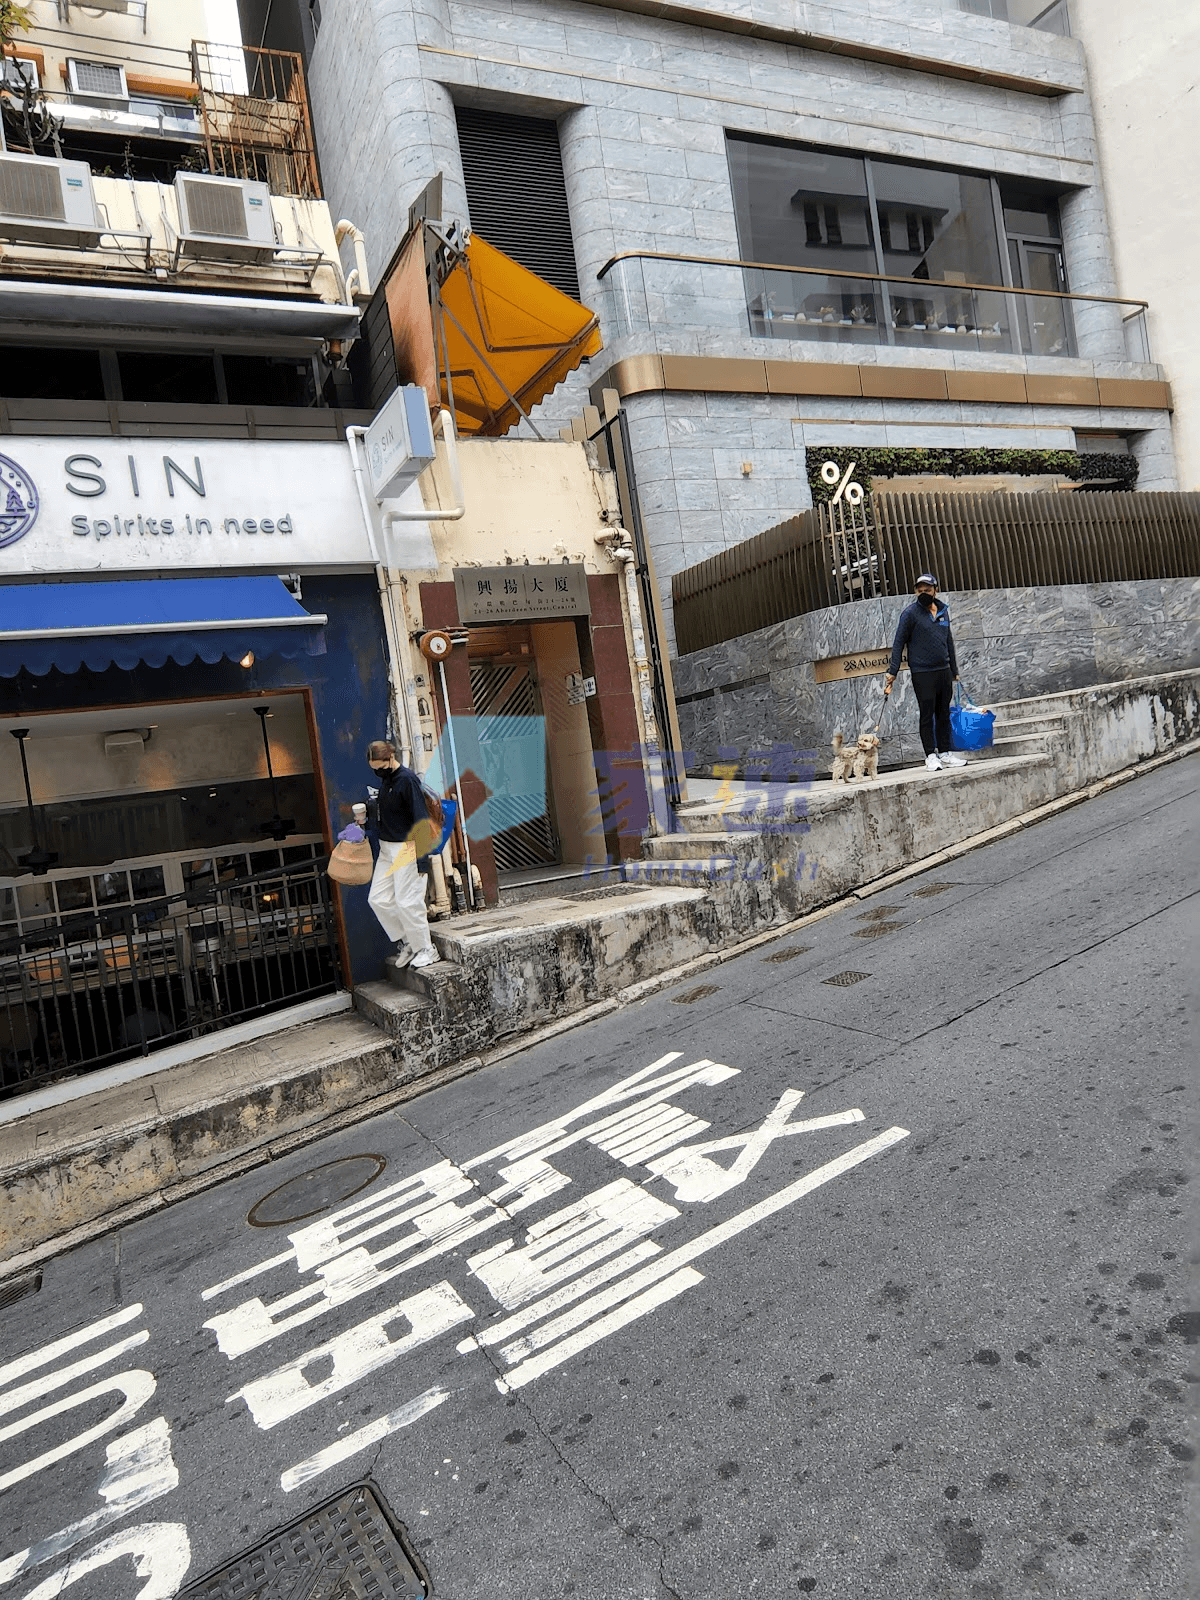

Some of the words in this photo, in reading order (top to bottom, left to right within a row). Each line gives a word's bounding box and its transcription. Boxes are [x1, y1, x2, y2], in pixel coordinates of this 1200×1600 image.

[381, 425, 394, 452] SIN
[64, 454, 206, 497] SIN
[71, 514, 174, 540] Spirits
[185, 514, 212, 534] in
[224, 513, 293, 534] need
[477, 576, 568, 596] 興揚大廈
[495, 606, 528, 614] Aberdeen
